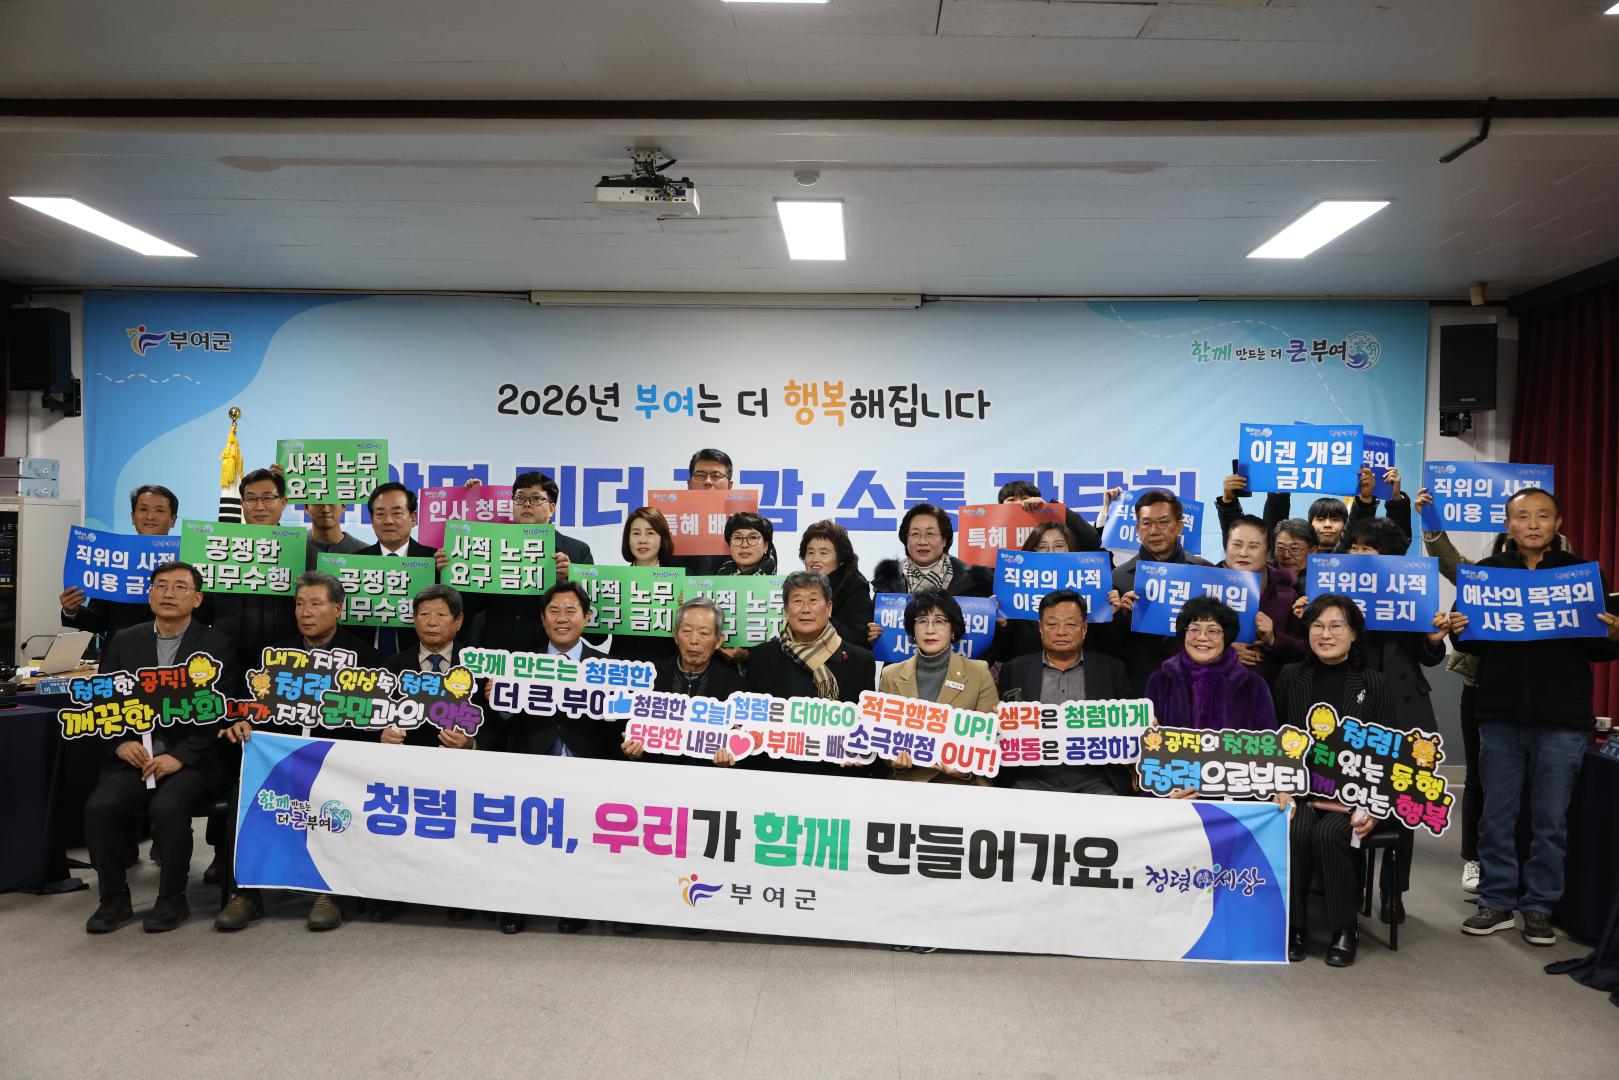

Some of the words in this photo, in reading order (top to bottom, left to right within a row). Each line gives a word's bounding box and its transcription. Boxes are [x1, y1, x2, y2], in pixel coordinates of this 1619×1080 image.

[169, 331, 231, 351] 부여군
[1191, 339, 1232, 362] 함께
[1236, 348, 1266, 361] 만드는
[1270, 348, 1282, 360] 더
[1286, 339, 1308, 363] 큰
[1311, 339, 1347, 362] 부여
[497, 382, 620, 422] 2026년
[635, 383, 722, 424] 부여는
[737, 387, 769, 418] 더
[784, 379, 992, 428] 행복해집니다
[287, 453, 328, 475] 사적
[336, 453, 378, 475] 노무
[1250, 440, 1296, 465] 이권
[1307, 441, 1352, 466] 개입
[287, 478, 329, 500] 요구
[336, 478, 377, 499] 금지
[1276, 467, 1322, 490] 금지
[1434, 478, 1492, 498] 직위의
[429, 501, 469, 521] 인사
[475, 499, 515, 522] 청탁
[1443, 503, 1482, 523] 이용
[205, 535, 281, 565] 공정한
[451, 535, 491, 561] 사적
[501, 539, 545, 563] 노무
[968, 526, 1007, 549] 특혜
[76, 544, 129, 570] 직위의
[83, 570, 118, 593] 이용
[193, 563, 292, 592] 직무수행
[339, 568, 411, 596] 공정한
[450, 563, 492, 588] 요구
[501, 566, 543, 590] 금지
[1004, 567, 1058, 590] 직위의
[1065, 569, 1101, 590] 사적
[1318, 571, 1378, 593] 직위의
[1385, 573, 1427, 596] 사적
[630, 581, 674, 605] 노무
[1145, 578, 1191, 606] 이권
[1463, 584, 1523, 608] 예산의
[1528, 581, 1595, 605] 목적외
[341, 597, 414, 624] 무수행
[630, 607, 673, 632] 금지
[1375, 600, 1416, 622] 금지
[1482, 611, 1526, 634] 사용
[1533, 609, 1580, 631] 금지
[265, 650, 309, 669] 내가
[463, 652, 506, 677] 함께
[513, 656, 578, 682] 만드는
[585, 662, 653, 688] 청렴한
[72, 675, 135, 701] 청렴한
[140, 667, 188, 693] 공직!
[275, 671, 331, 701] 청렴
[493, 682, 520, 709] 더
[528, 684, 553, 712] 큰
[62, 698, 155, 736] 깨끗한
[162, 689, 223, 724] 사회
[227, 701, 270, 720] 내가
[321, 693, 425, 725] 군민과의
[429, 700, 481, 733] 약속
[633, 694, 687, 722] 청렴한
[689, 701, 733, 726] 오늘!
[733, 695, 785, 723] 청렴은
[790, 701, 856, 728] 더하GO
[862, 695, 949, 735] 적극행정
[954, 712, 995, 742] UP!
[999, 705, 1058, 731] 생각은
[1065, 703, 1150, 729] 청렴하게
[630, 723, 683, 750] 당당한
[687, 730, 728, 754] 내일!
[767, 730, 821, 757] 부패는
[847, 724, 937, 763] 소극행정
[941, 742, 999, 774] OUT!
[999, 737, 1060, 762] 행동은
[1164, 731, 1221, 754] 공직의
[1343, 720, 1404, 760] 청렴!
[1141, 758, 1305, 795] 청렴으로부터
[1337, 750, 1385, 784] 있는
[258, 790, 290, 811] 함께
[290, 800, 312, 812] 만드는
[1341, 783, 1390, 815] 여는
[1396, 793, 1450, 834] 행복
[277, 813, 289, 824] 더
[291, 811, 307, 829] 큰
[306, 815, 331, 832] 부여
[363, 781, 457, 839] 청렴
[471, 792, 580, 854] 부여,
[592, 801, 743, 863] 우리가
[753, 810, 850, 871] 함께
[866, 821, 1135, 889] 만들어가요.
